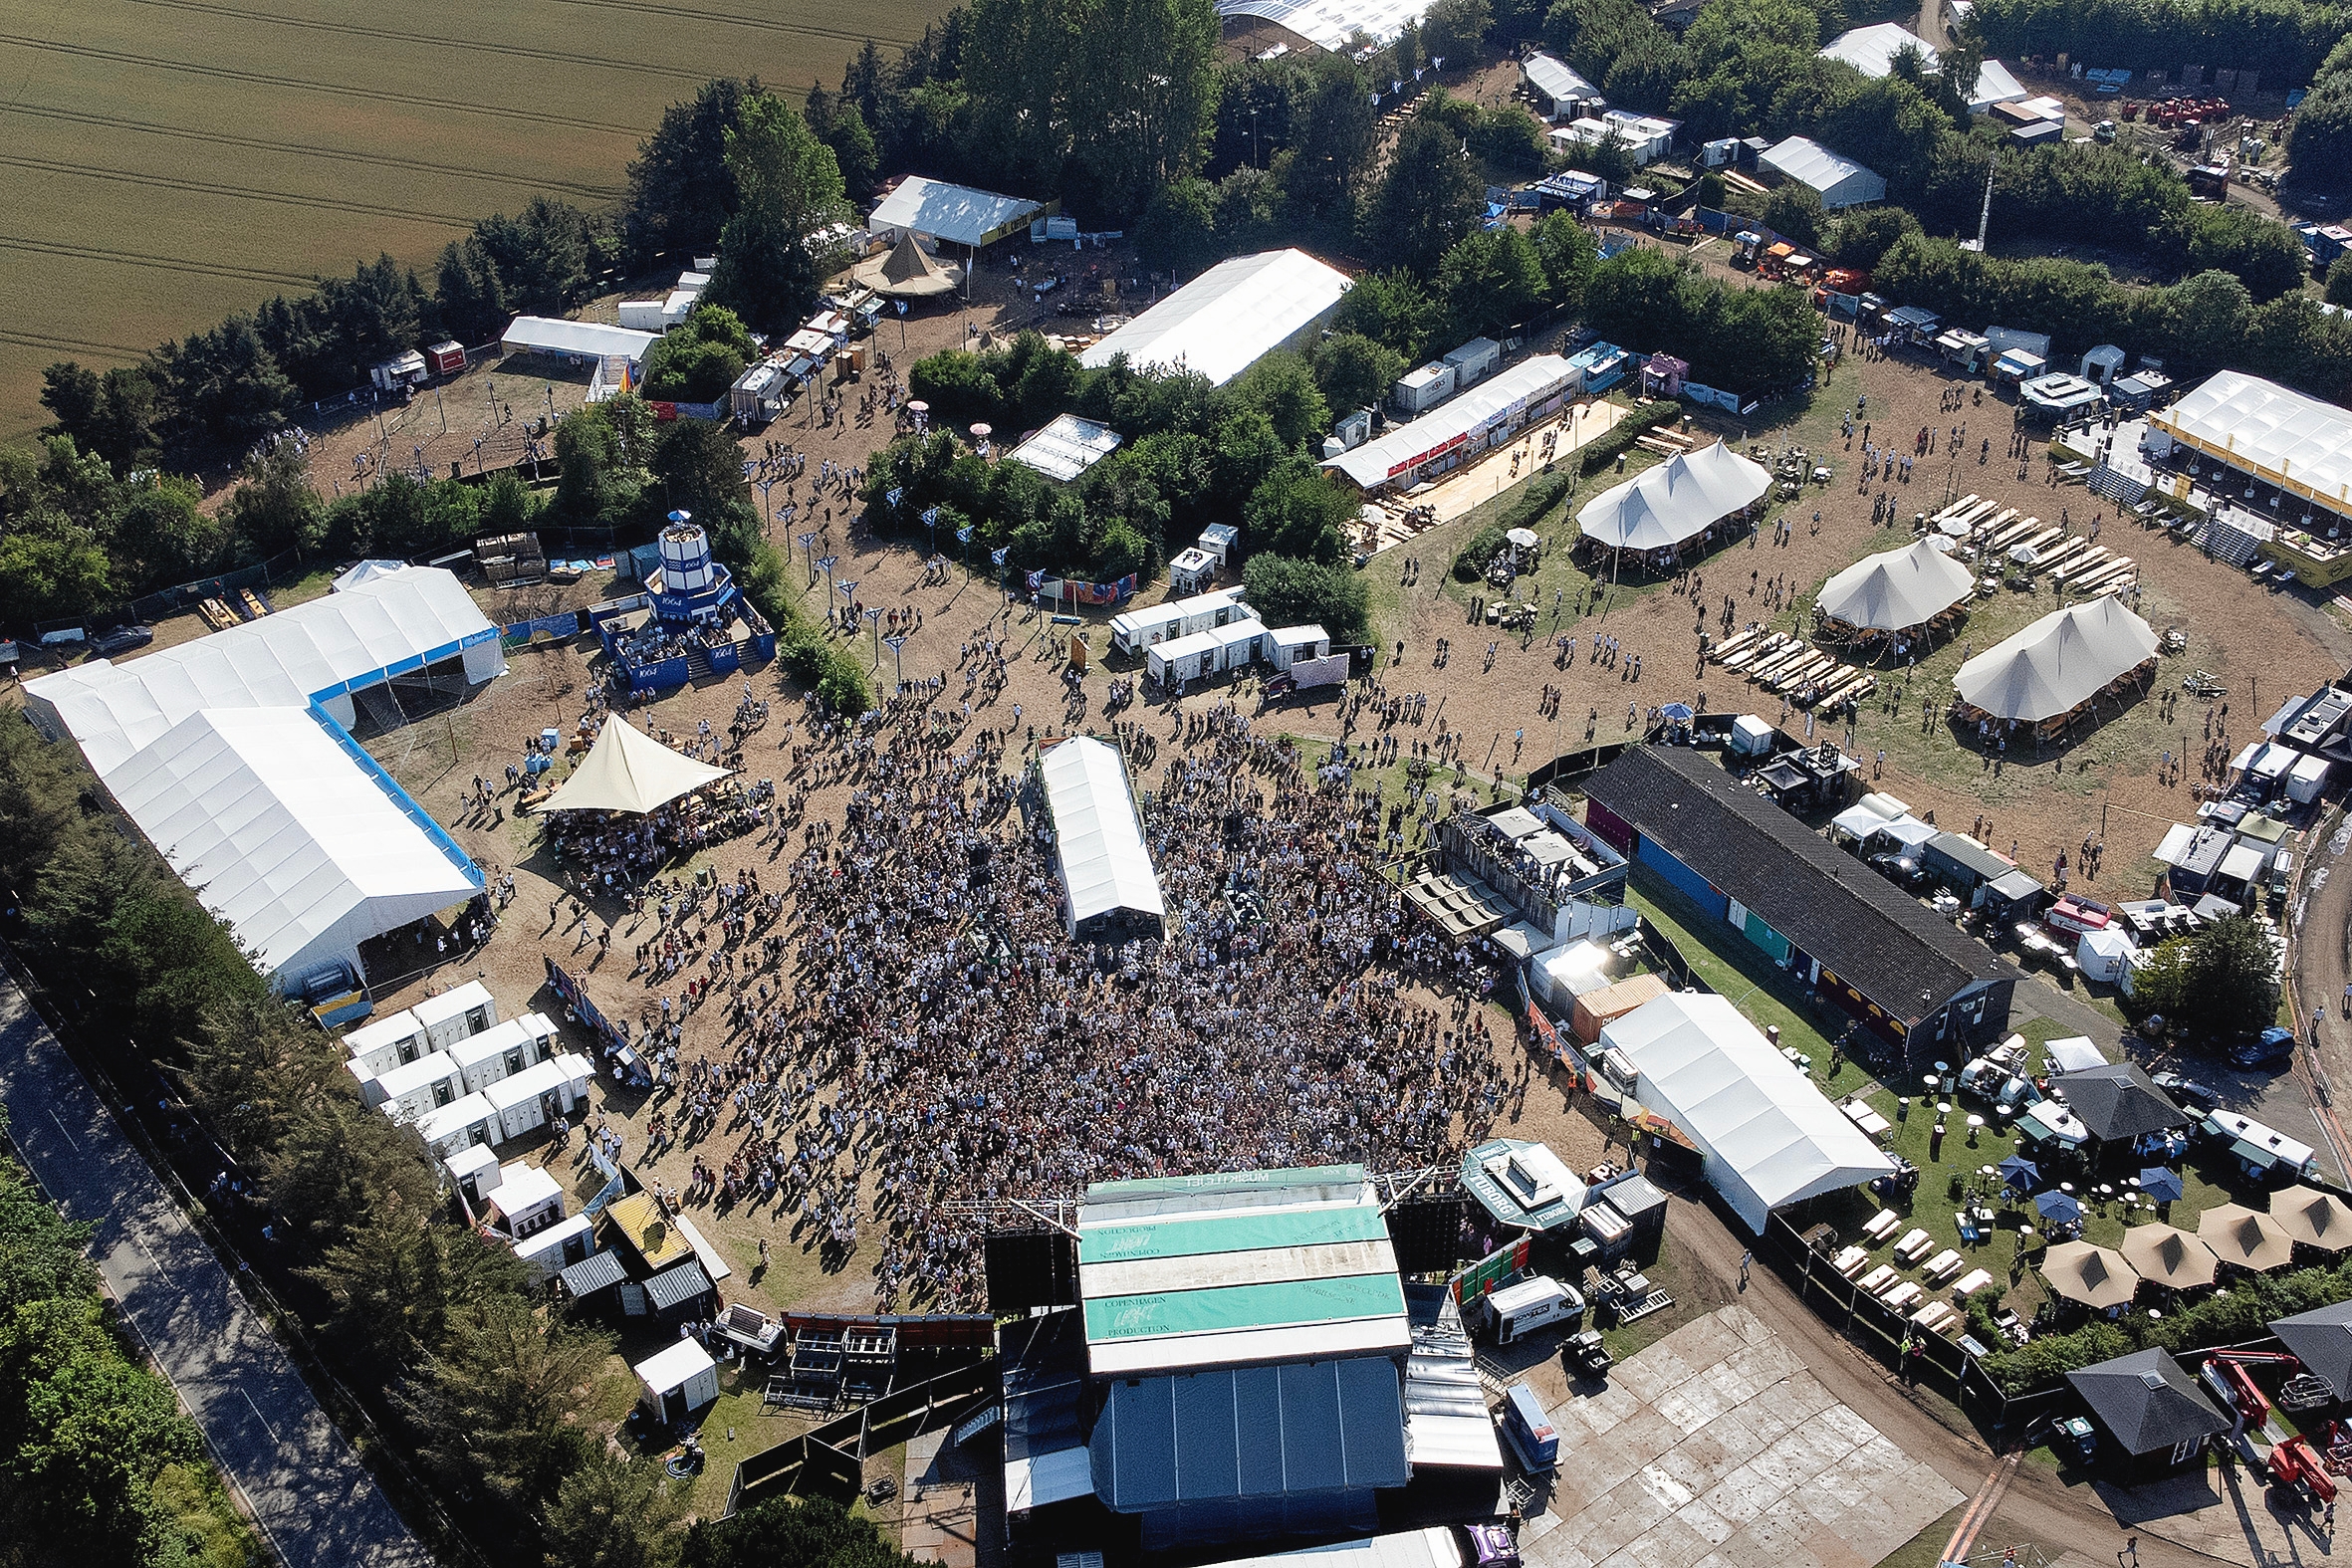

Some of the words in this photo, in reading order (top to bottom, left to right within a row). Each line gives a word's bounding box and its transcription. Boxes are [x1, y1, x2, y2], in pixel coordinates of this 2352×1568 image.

[661, 596, 683, 607] 1664
[714, 647, 733, 659] 1664
[638, 667, 658, 679] 1664
[1469, 1174, 1515, 1215] TUBORG
[1536, 1206, 1569, 1223] TUBORG
[1098, 1226, 1156, 1235] PRODUCTION
[1104, 1296, 1166, 1308] COPENHAGEN
[1107, 1325, 1170, 1337] PRODUCTION
